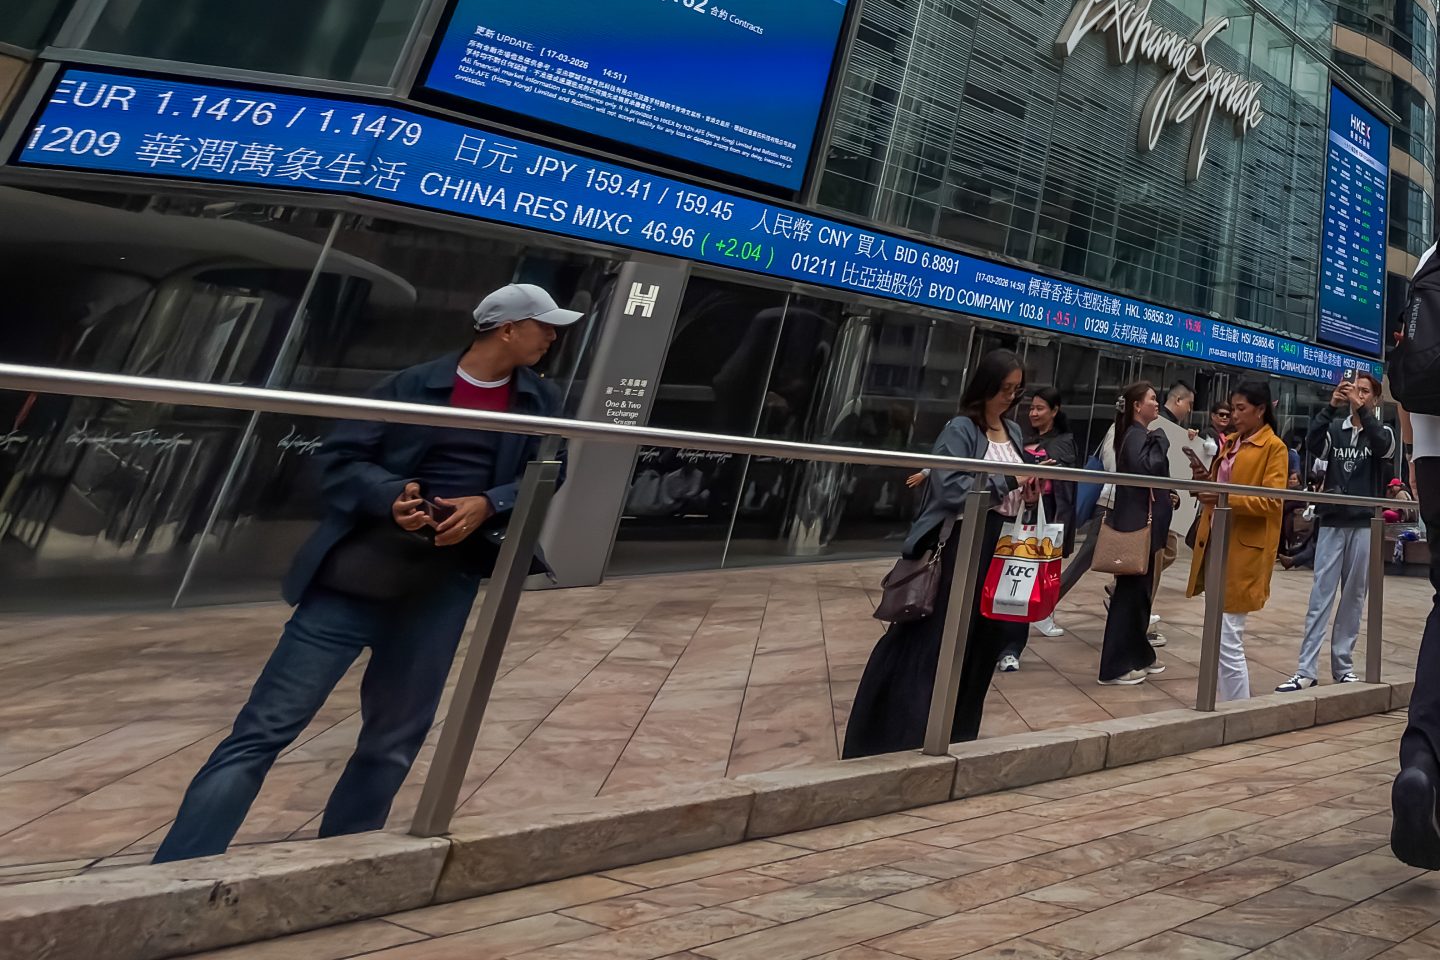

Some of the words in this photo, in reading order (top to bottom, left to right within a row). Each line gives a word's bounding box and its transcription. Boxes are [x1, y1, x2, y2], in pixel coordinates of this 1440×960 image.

[729, 14, 764, 35] Contracts
[496, 33, 536, 52] UPDATE:
[1350, 114, 1371, 140] HKEX
[50, 79, 136, 111] EUR
[157, 91, 277, 126] 1.1476
[286, 107, 306, 128] /
[320, 109, 422, 146] 1.1479
[454, 133, 518, 174] 日元
[526, 155, 578, 182] JPY
[586, 168, 652, 201] 159.41
[657, 187, 669, 205] /
[675, 190, 735, 221] 159.45
[750, 208, 814, 242] 人民幣
[818, 226, 853, 249] CNY
[855, 233, 888, 261] 買入
[894, 245, 918, 264] BID
[921, 251, 960, 275] 6.8891
[1125, 303, 1140, 319] HKL
[135, 132, 408, 192] 華潤萬象生活
[419, 172, 506, 210] CHINA
[513, 192, 569, 222] RES
[572, 205, 633, 235] MIXC
[641, 220, 696, 248] 46.96
[791, 252, 837, 278] 01211
[841, 261, 923, 299] 比亞迪股份
[928, 282, 955, 302] BYD
[957, 288, 1015, 314] COMPANY
[1018, 302, 1044, 321] 103.8
[1084, 317, 1110, 334] 01299
[1150, 332, 1163, 346] AIA
[1164, 335, 1180, 349] 83.5
[605, 399, 620, 408] One
[620, 400, 627, 409] &
[628, 401, 642, 409] Two
[606, 408, 639, 419] Exchange
[1005, 565, 1034, 578] KFC
